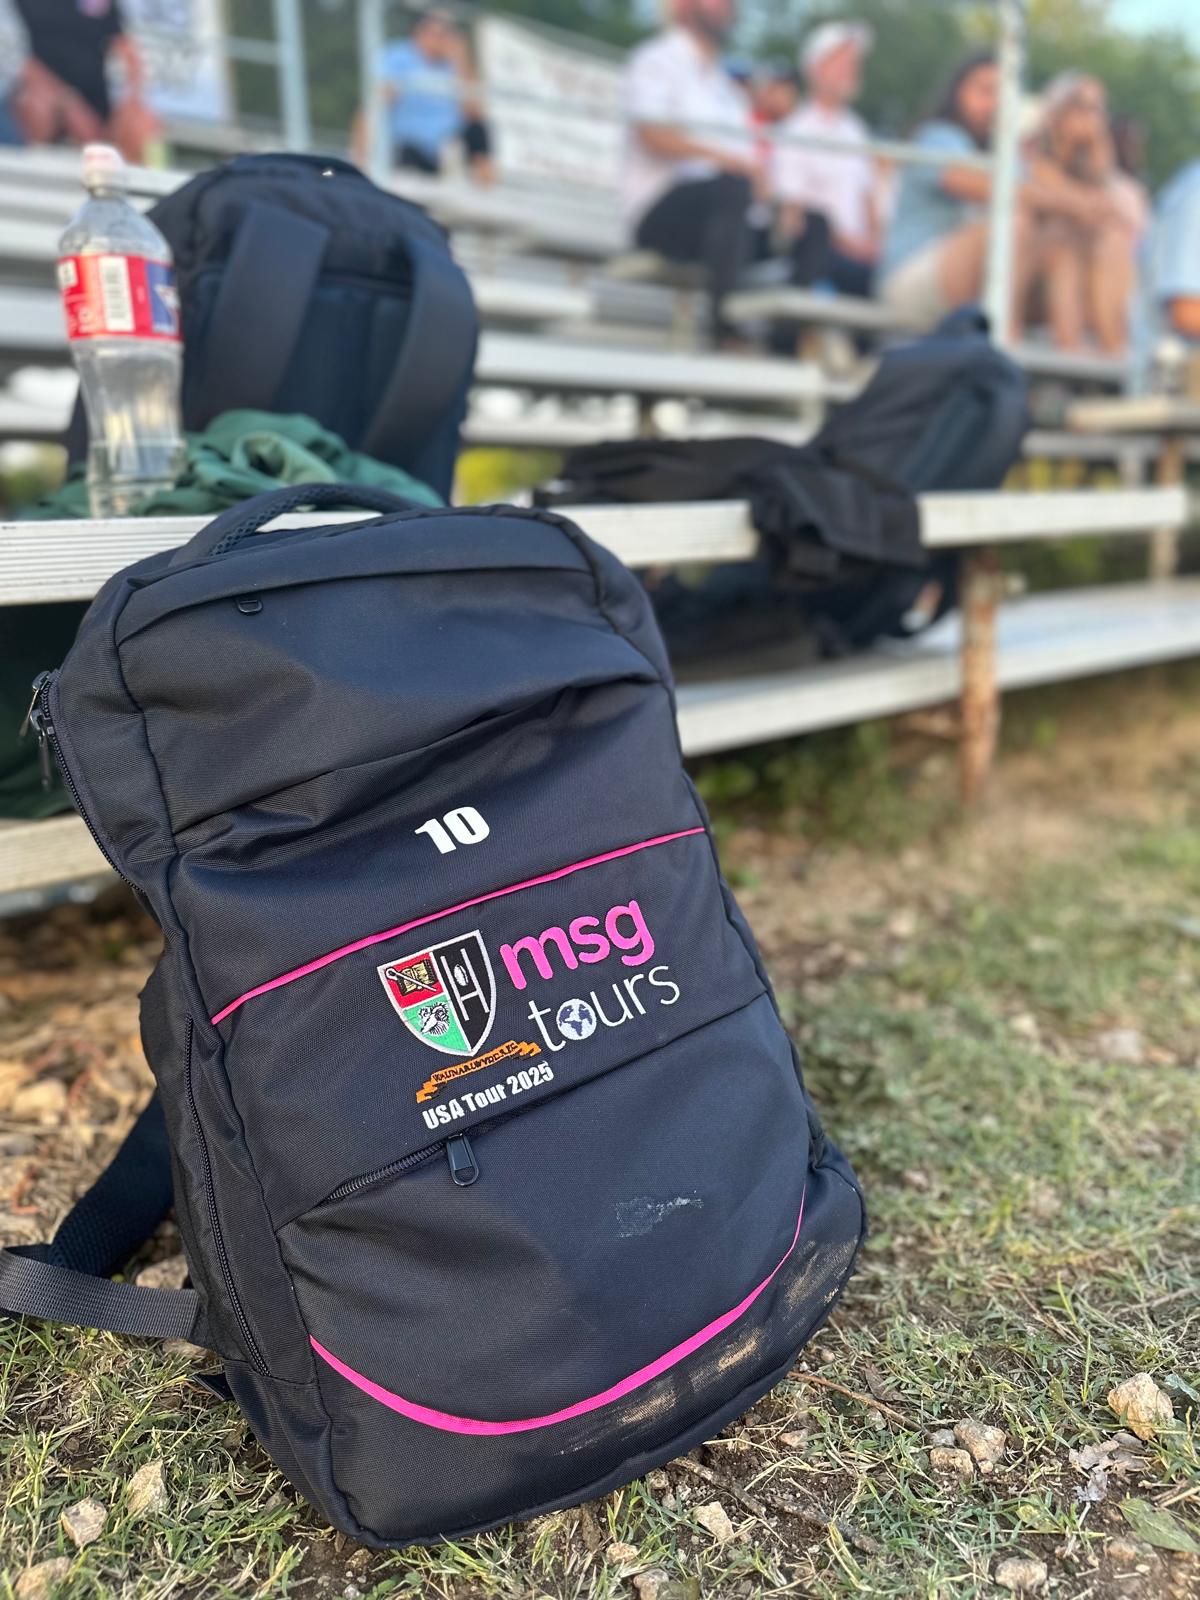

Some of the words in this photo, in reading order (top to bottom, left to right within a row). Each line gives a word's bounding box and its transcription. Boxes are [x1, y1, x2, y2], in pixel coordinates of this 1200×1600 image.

[414, 806, 491, 855] 10
[499, 900, 655, 990] msg
[526, 964, 681, 1052] tours
[421, 1098, 466, 1130] USA
[460, 1083, 507, 1112] Tour
[506, 1060, 555, 1095] 2025
